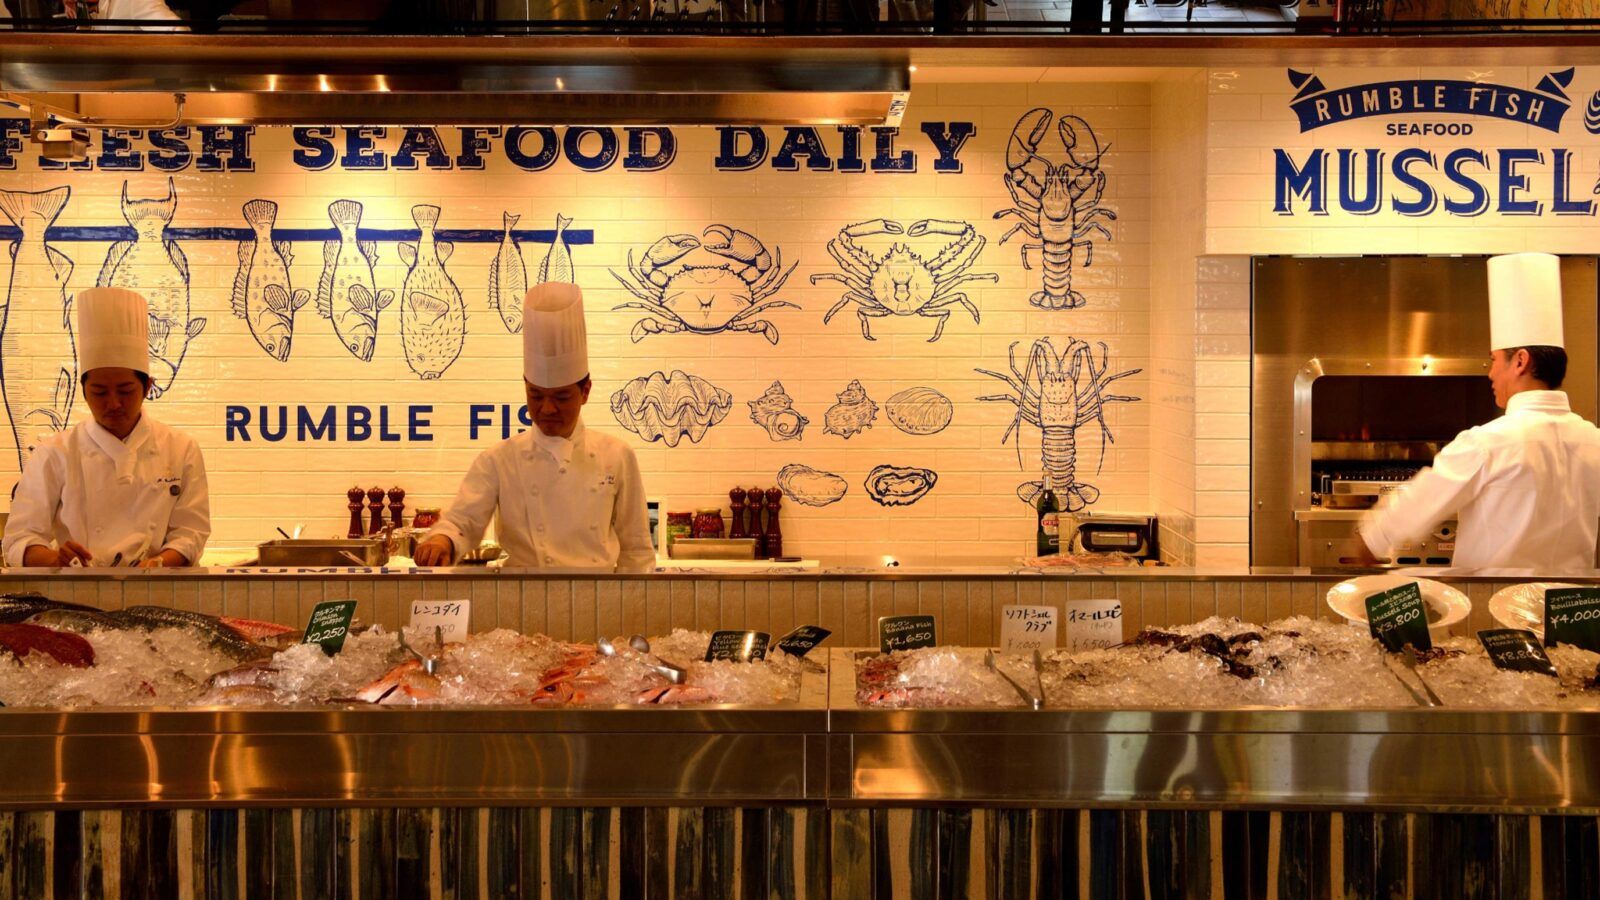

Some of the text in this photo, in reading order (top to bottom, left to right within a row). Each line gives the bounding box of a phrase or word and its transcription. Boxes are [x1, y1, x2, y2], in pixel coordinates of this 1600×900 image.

[1315, 85, 1545, 122] RUMBLE FISH
[1386, 123, 1474, 136] SEAFOOD
[293, 125, 678, 172] SEAFOOD
[715, 122, 976, 173] DAILY
[1273, 147, 1598, 217] MUSSEL
[226, 405, 434, 442] RUMBLE
[414, 603, 461, 616] レンコダイ
[1550, 609, 1600, 629] ¥4,000
[1025, 620, 1052, 633] クラブ
[1376, 608, 1420, 638] ¥3,800
[885, 632, 932, 649] ¥1,650
